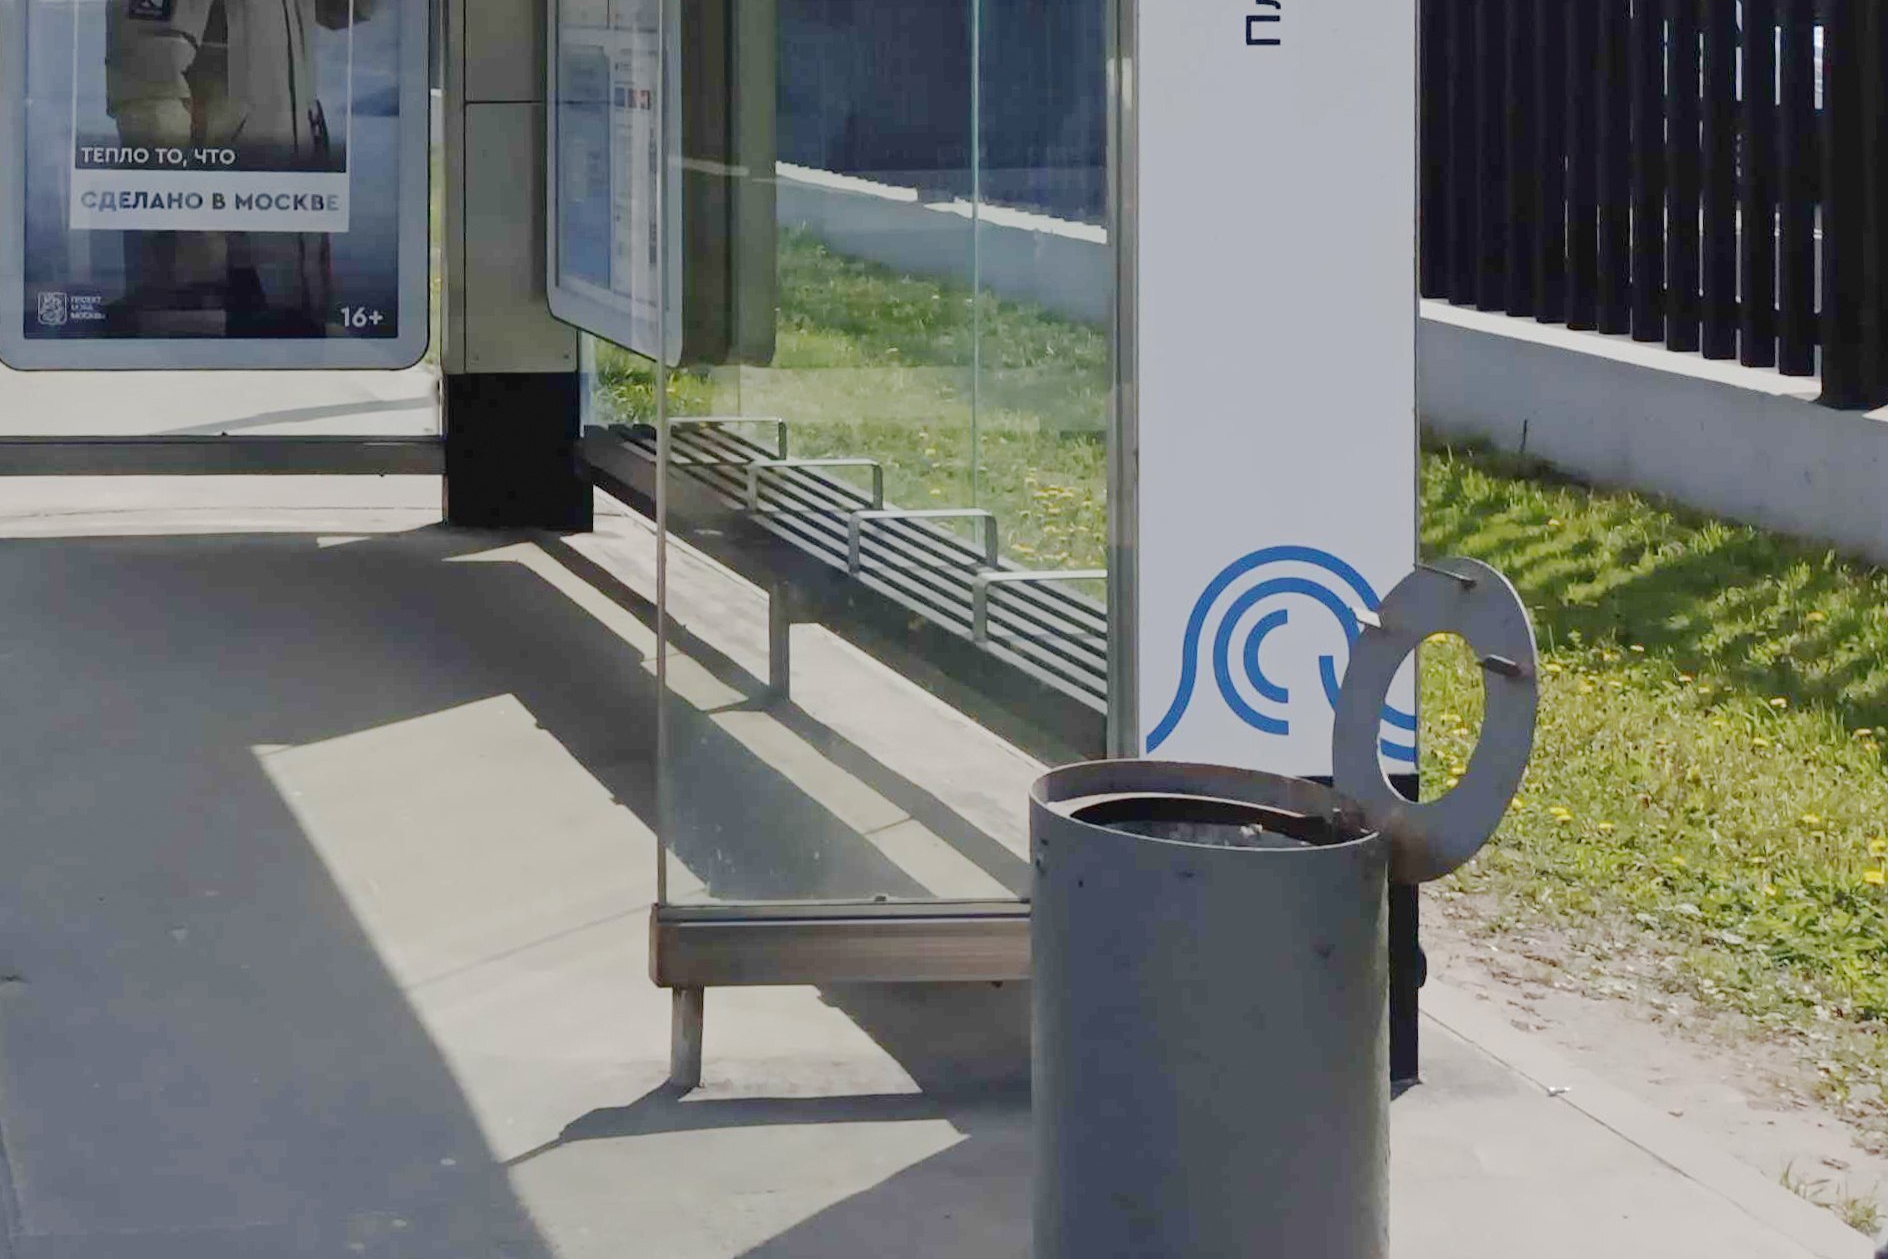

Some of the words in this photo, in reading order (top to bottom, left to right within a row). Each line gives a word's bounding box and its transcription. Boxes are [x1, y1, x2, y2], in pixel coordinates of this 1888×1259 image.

[81, 146, 149, 164] ТЕПЛО
[155, 147, 187, 167] ТО,
[194, 148, 236, 165] ЧТО
[81, 191, 203, 213] СДЕЛАНО
[212, 192, 226, 210] В
[235, 193, 340, 212] МОСКВЕ
[341, 306, 383, 328] 16+
